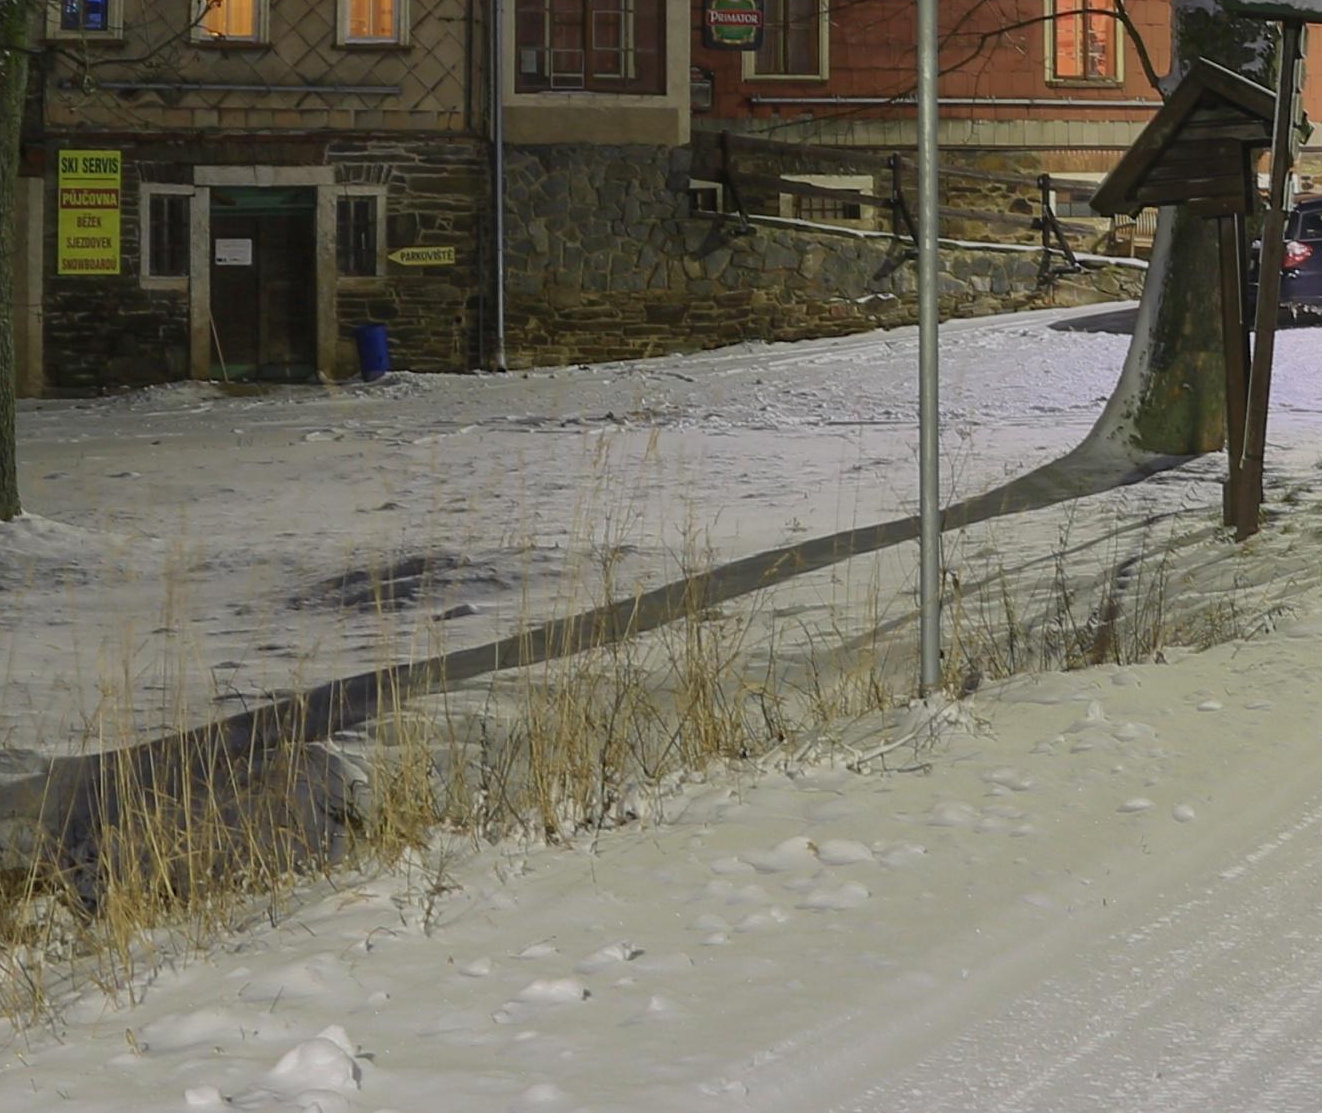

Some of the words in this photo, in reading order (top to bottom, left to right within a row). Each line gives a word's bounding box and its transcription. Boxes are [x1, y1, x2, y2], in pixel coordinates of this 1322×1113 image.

[710, 11, 758, 23] PRIMATOR
[61, 157, 78, 174] SKI
[82, 157, 118, 174] SERVIS
[62, 190, 118, 206] PŮJČOVNA
[66, 236, 113, 248] SJEZDOVEK
